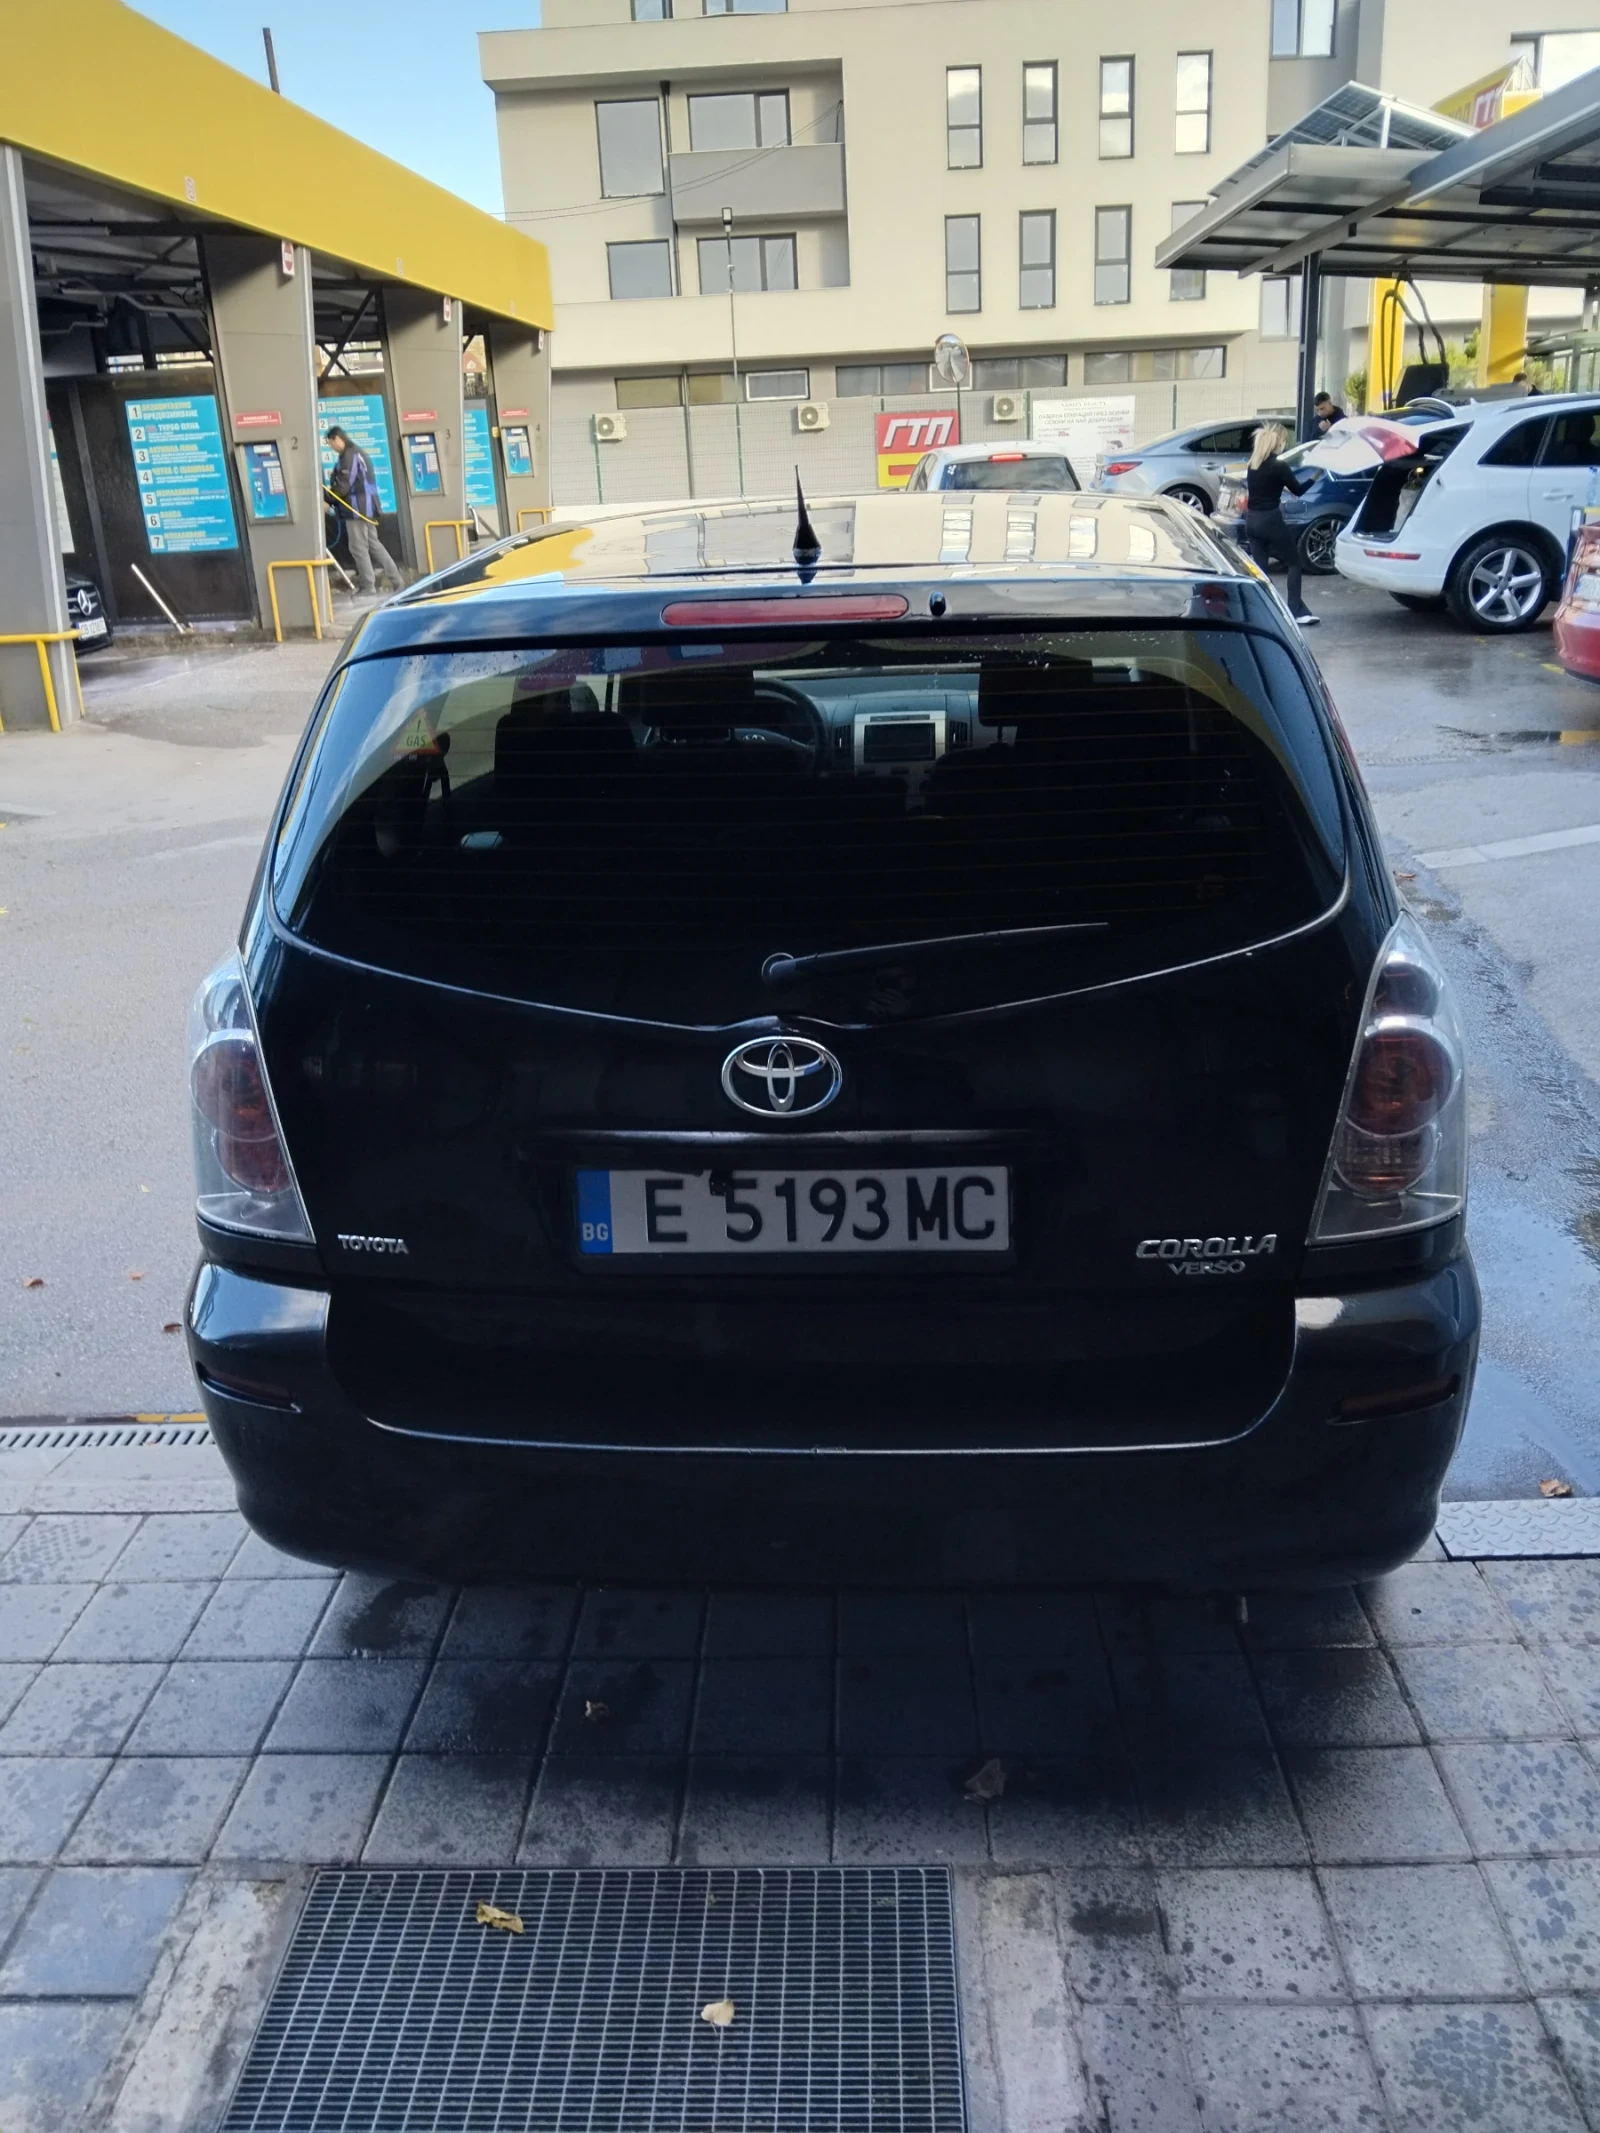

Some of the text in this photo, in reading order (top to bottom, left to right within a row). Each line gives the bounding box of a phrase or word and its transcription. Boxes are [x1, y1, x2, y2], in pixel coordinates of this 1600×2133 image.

[132, 407, 138, 418] 1
[135, 429, 142, 440] 2
[445, 428, 451, 439] 3
[883, 417, 953, 448] ГТП
[291, 436, 299, 450] 2
[139, 451, 146, 461] 3
[143, 472, 149, 482] 4
[146, 494, 153, 505] 5
[150, 516, 157, 526] 6
[154, 537, 160, 547] 7
[406, 734, 426, 747] GAS
[582, 1176, 996, 1243] BG E 5193 MC
[338, 1234, 409, 1255] TOYOTA
[1135, 1233, 1277, 1259] COROLLA
[1168, 1260, 1246, 1276] VERSO
